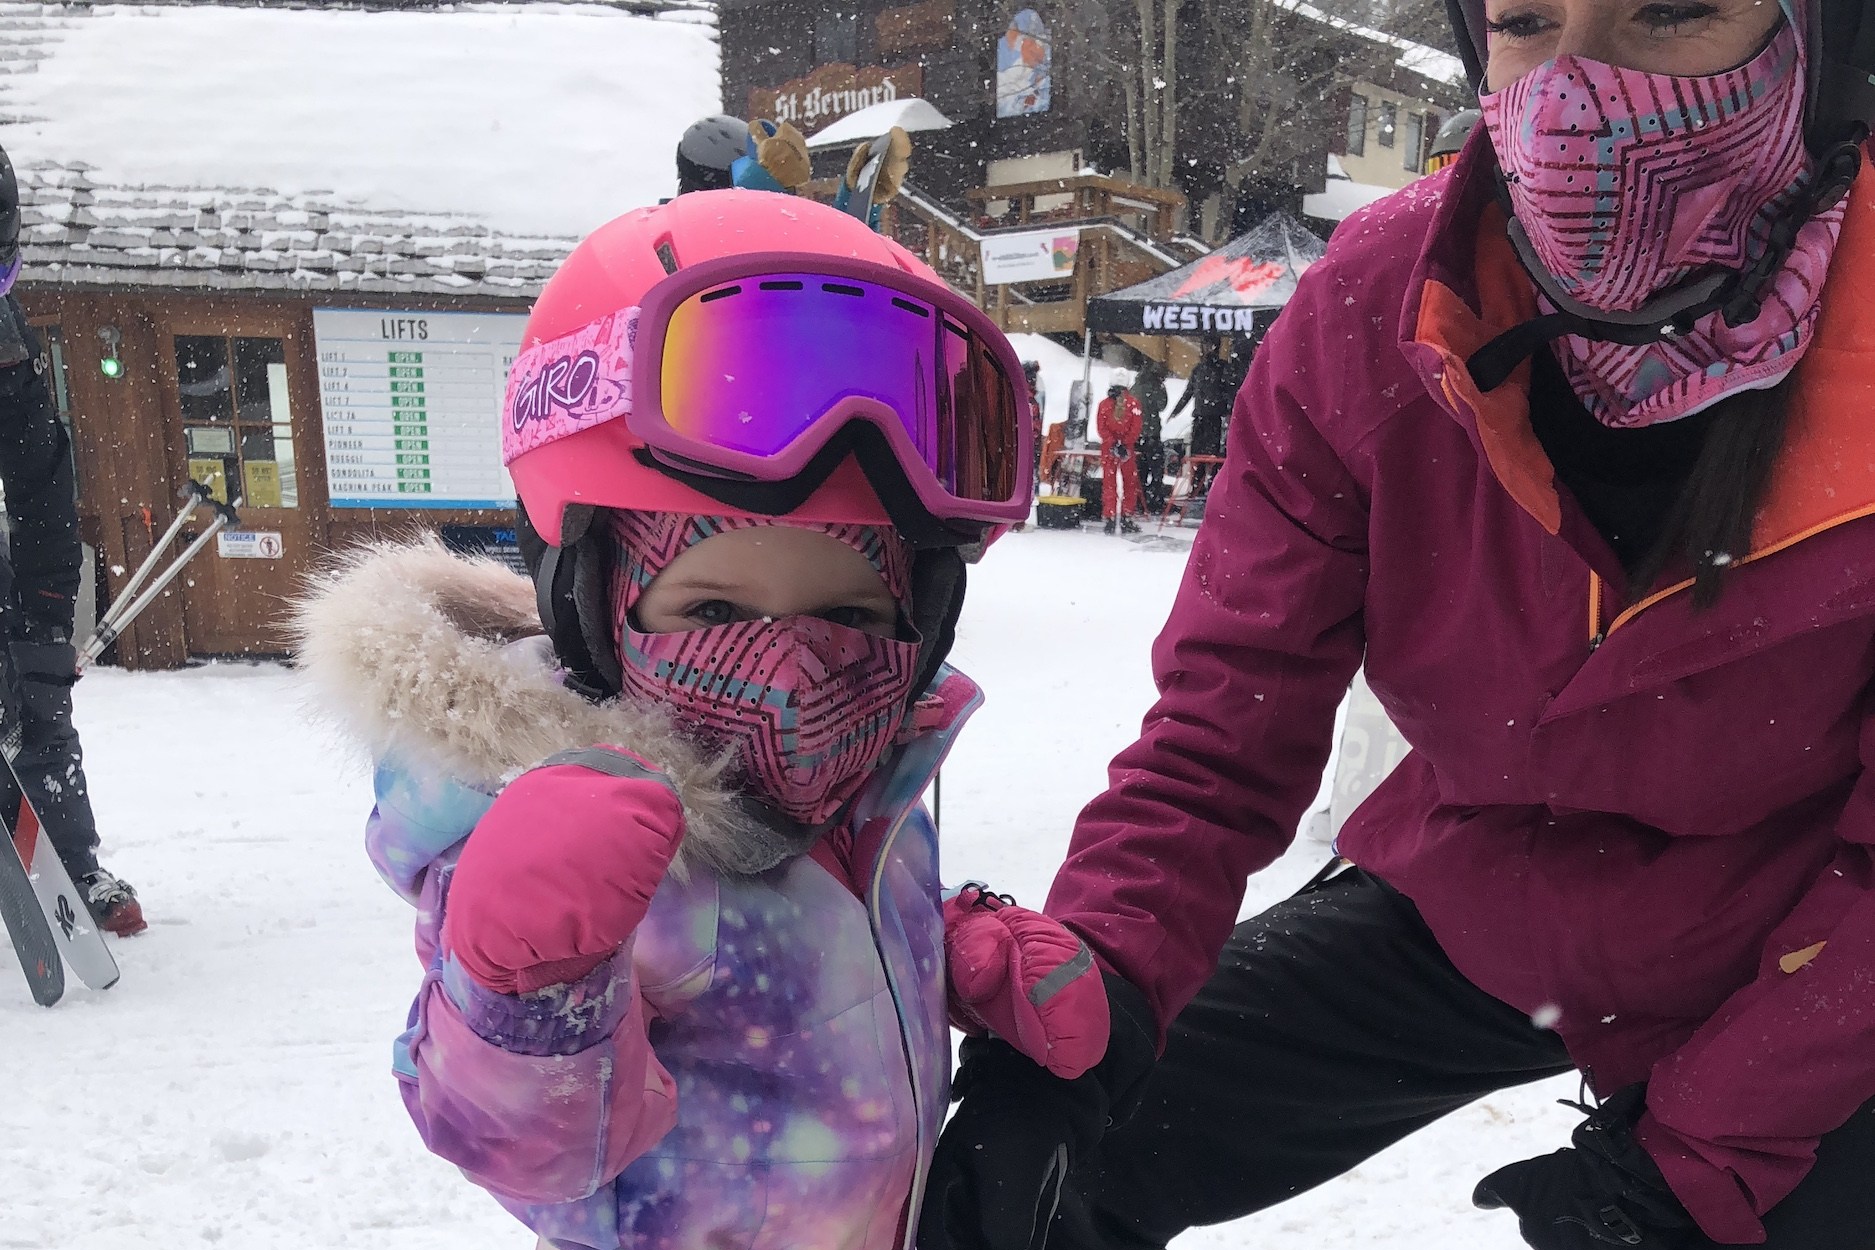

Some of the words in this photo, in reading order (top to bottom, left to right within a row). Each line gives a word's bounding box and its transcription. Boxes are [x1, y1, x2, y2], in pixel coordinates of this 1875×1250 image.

[803, 77, 897, 127] Bernard
[1142, 304, 1254, 331] WESTON
[381, 318, 429, 341] LIFTS
[321, 352, 338, 362] LIFT
[394, 352, 417, 363] OPEN
[322, 367, 340, 377] LIFT
[395, 367, 418, 378] OPEN
[324, 382, 341, 392] LIFT
[396, 382, 419, 392] OPEN
[513, 353, 599, 432] GIRO
[325, 396, 342, 406] LIFT
[398, 396, 420, 407] OPEN
[399, 411, 421, 421] OPEN
[327, 425, 344, 435] LIFT
[400, 425, 422, 436] OPEN
[329, 440, 363, 449] PIONEER
[401, 440, 423, 450] OPEN
[402, 454, 424, 465] OPEN
[403, 468, 425, 479] OPEN
[371, 483, 393, 492] PEAK
[404, 482, 426, 493] OPEN
